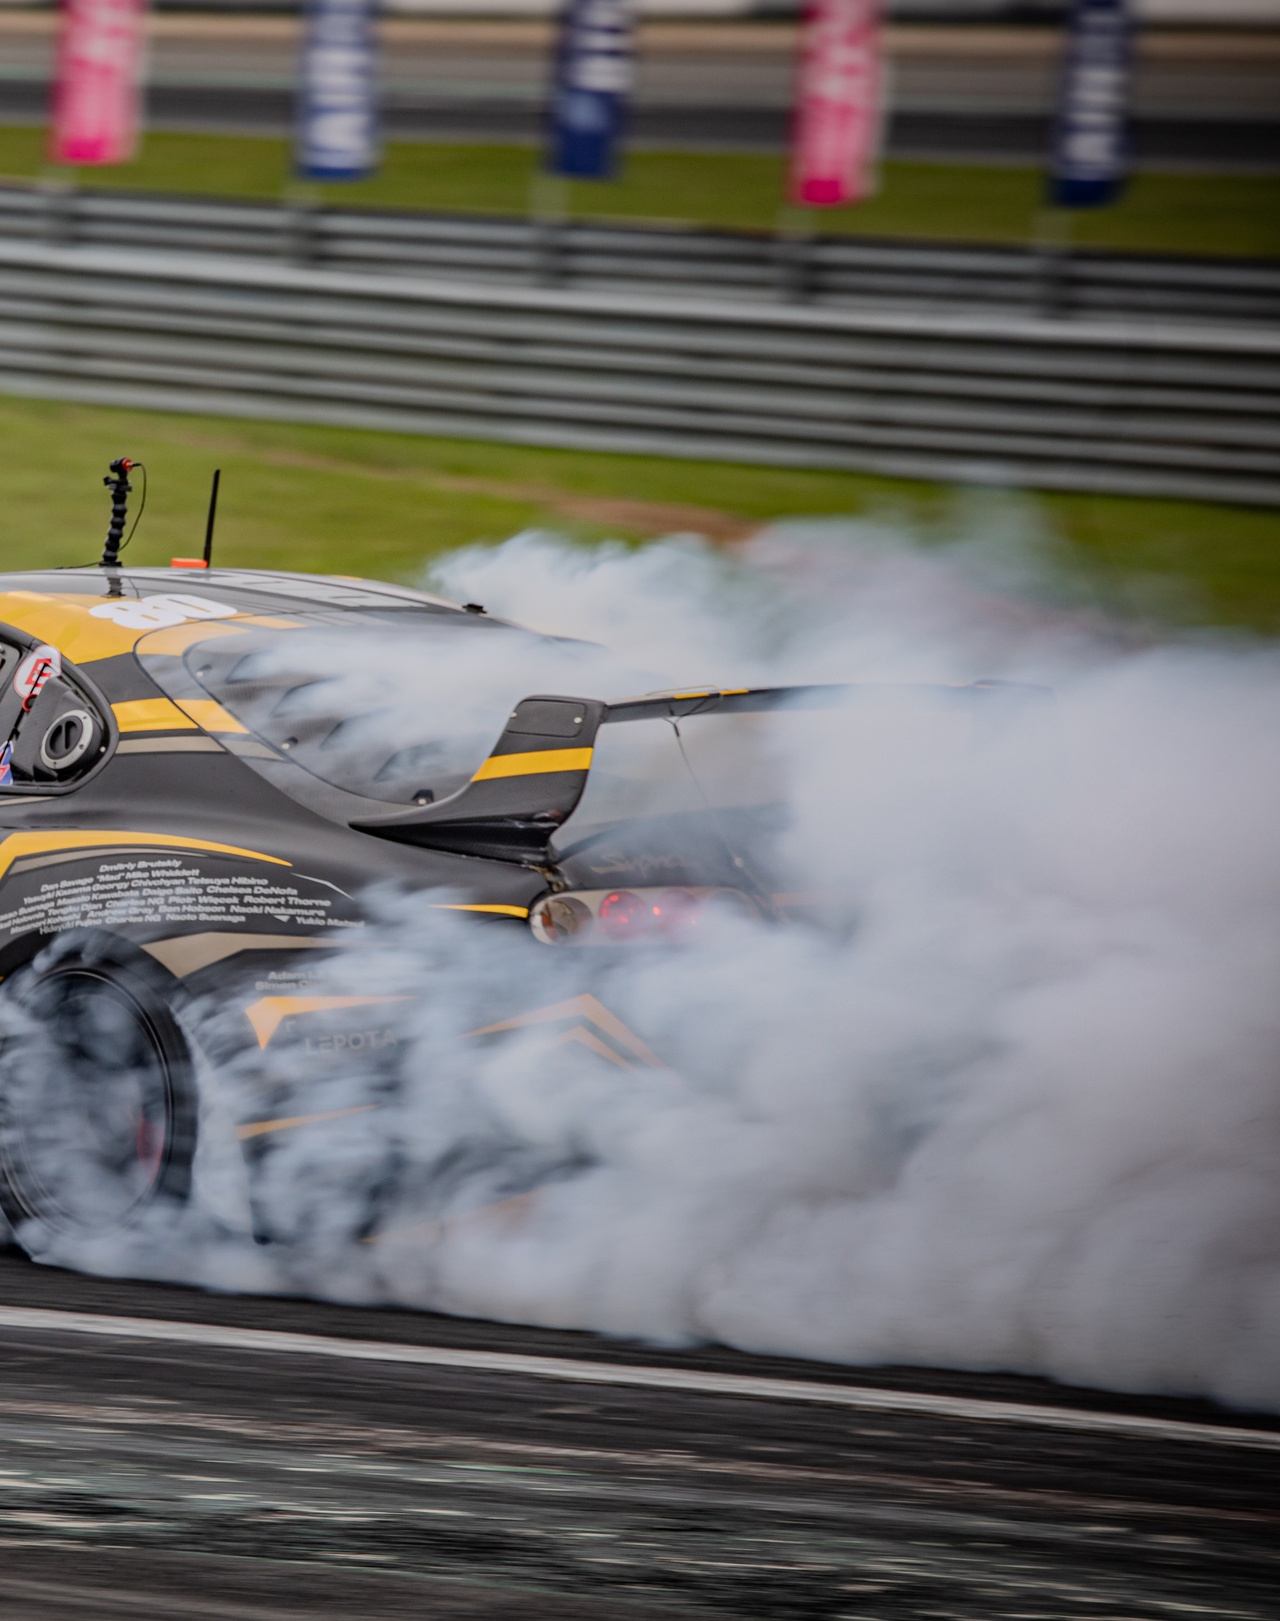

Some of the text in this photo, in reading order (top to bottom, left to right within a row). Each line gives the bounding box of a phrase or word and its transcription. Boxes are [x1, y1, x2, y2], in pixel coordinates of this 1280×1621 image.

[40, 883, 59, 893] Dan
[59, 877, 94, 888] Savage
[125, 871, 150, 879] Mike
[187, 877, 230, 886] Tetsuya
[231, 876, 269, 885] Hibino
[174, 886, 203, 895] Saito
[206, 885, 252, 894] Chelsea
[253, 885, 298, 896] DeNofa
[147, 896, 165, 905] NG
[167, 895, 197, 904] Piotr
[243, 895, 286, 905] Robert
[286, 897, 332, 907] Thorne
[157, 905, 181, 913] Ben
[181, 904, 226, 913] Hobson
[264, 906, 326, 917] Nakamura
[295, 916, 326, 926] Yukio
